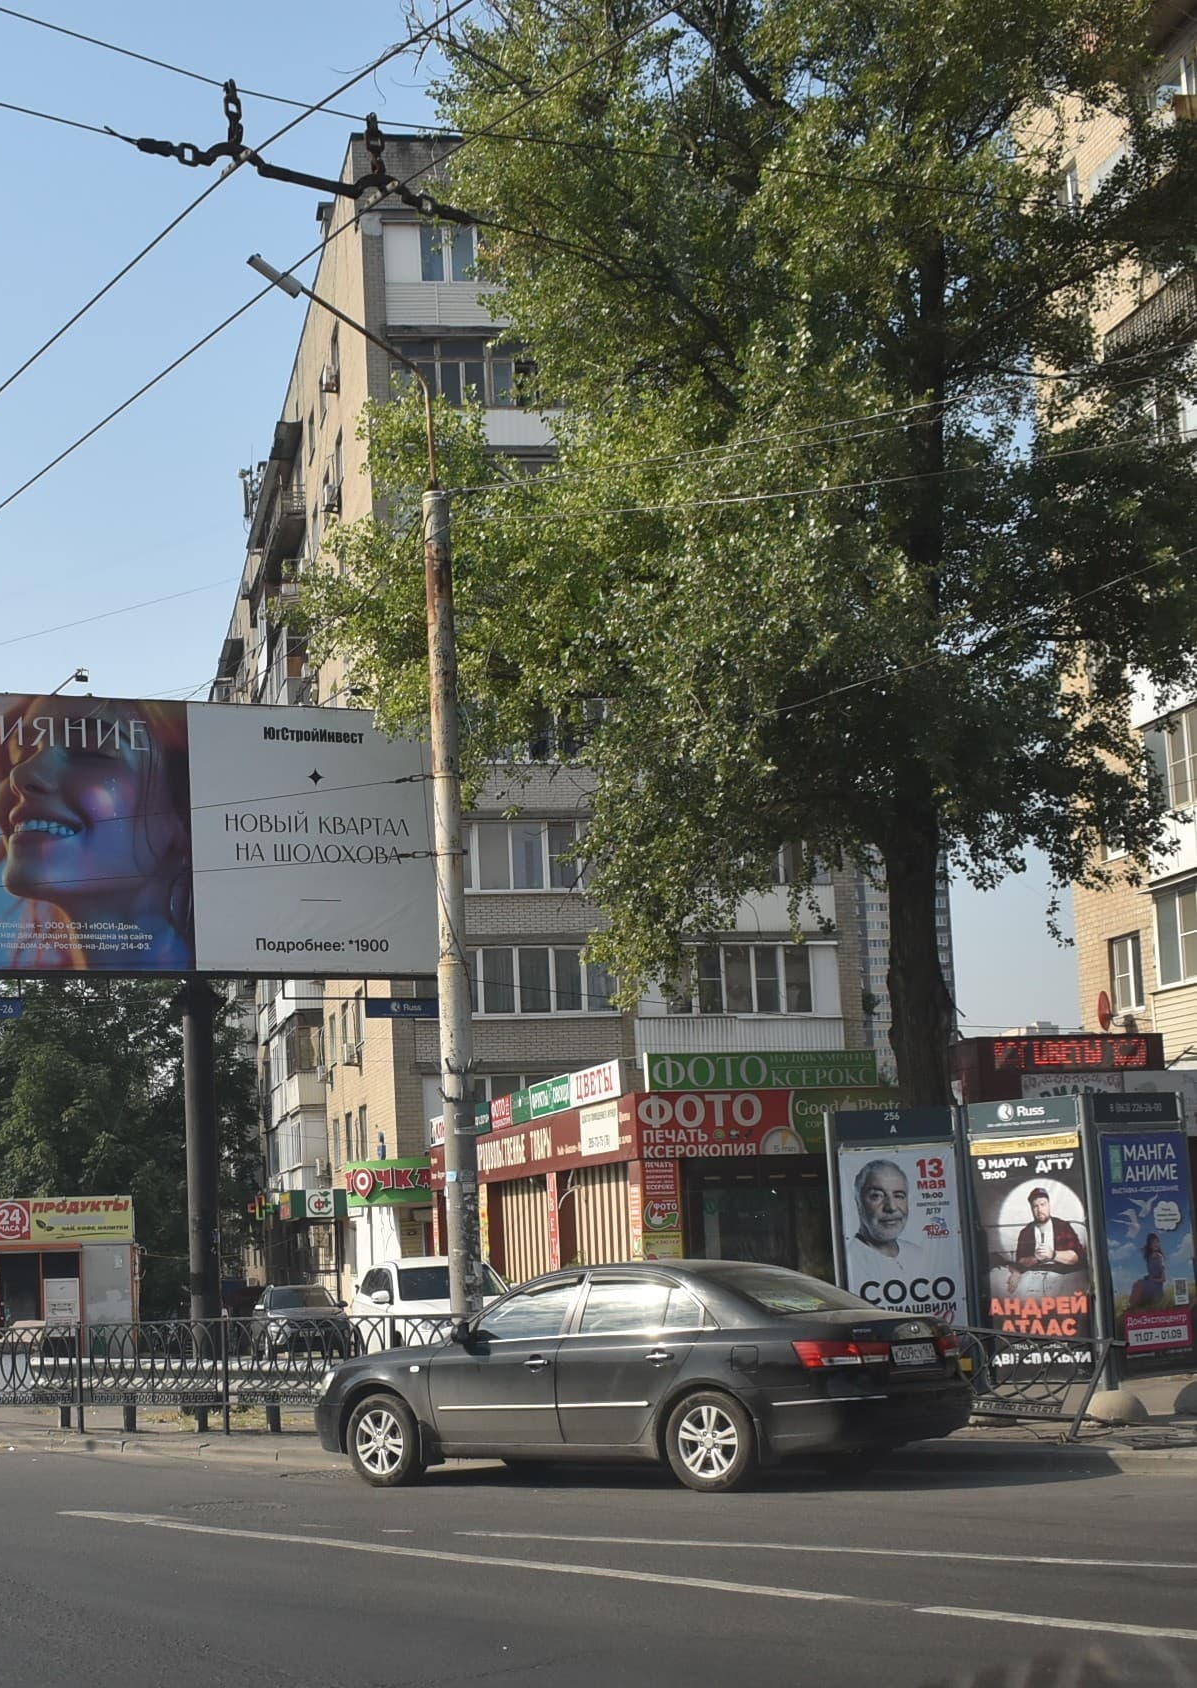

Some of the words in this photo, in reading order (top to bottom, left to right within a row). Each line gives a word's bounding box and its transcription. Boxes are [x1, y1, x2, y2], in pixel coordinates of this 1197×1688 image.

[263, 726, 364, 744] ЮгСтройИнвест
[224, 810, 309, 834] НОВЫЙ
[318, 815, 410, 837] КВАРТАЛ
[235, 842, 265, 862] НА
[273, 843, 403, 865] ШОЛОХОВА
[129, 932, 153, 941] сайте
[255, 936, 346, 954] Подробнее:
[1033, 1039, 1102, 1065] ЦВЕТЫ
[652, 1055, 768, 1089] ФОТО
[770, 1067, 872, 1088] КСЕРОКС
[575, 1065, 614, 1101] ЦВЕТЫ
[638, 1093, 763, 1129] ФОТО
[795, 1099, 839, 1116] Good
[883, 1112, 900, 1121] 256
[1016, 1105, 1045, 1117] Russ
[642, 1129, 708, 1144] ПЕЧАТЬ
[642, 1143, 757, 1159] КСЕРОКОПИЯ
[1123, 1143, 1176, 1162] МАНГА
[915, 1157, 944, 1178] 13
[977, 1158, 987, 1170] 9
[988, 1157, 1028, 1169] МАРТА
[1035, 1158, 1075, 1174] ДГТУ
[1125, 1163, 1179, 1182] АНИМЕ
[981, 1170, 1007, 1180] 19:00
[916, 1179, 946, 1190] мая
[32, 1199, 130, 1215] ПРОДУКТЫ
[653, 1202, 678, 1211] ФОТО
[0, 1225, 21, 1233] ЧАСА
[860, 1276, 956, 1305] СОСО
[882, 1301, 957, 1314] ЛИАШВИЛИ
[989, 1291, 1088, 1319] АНДРЕЙ
[1002, 1318, 1077, 1336] АТЛАС
